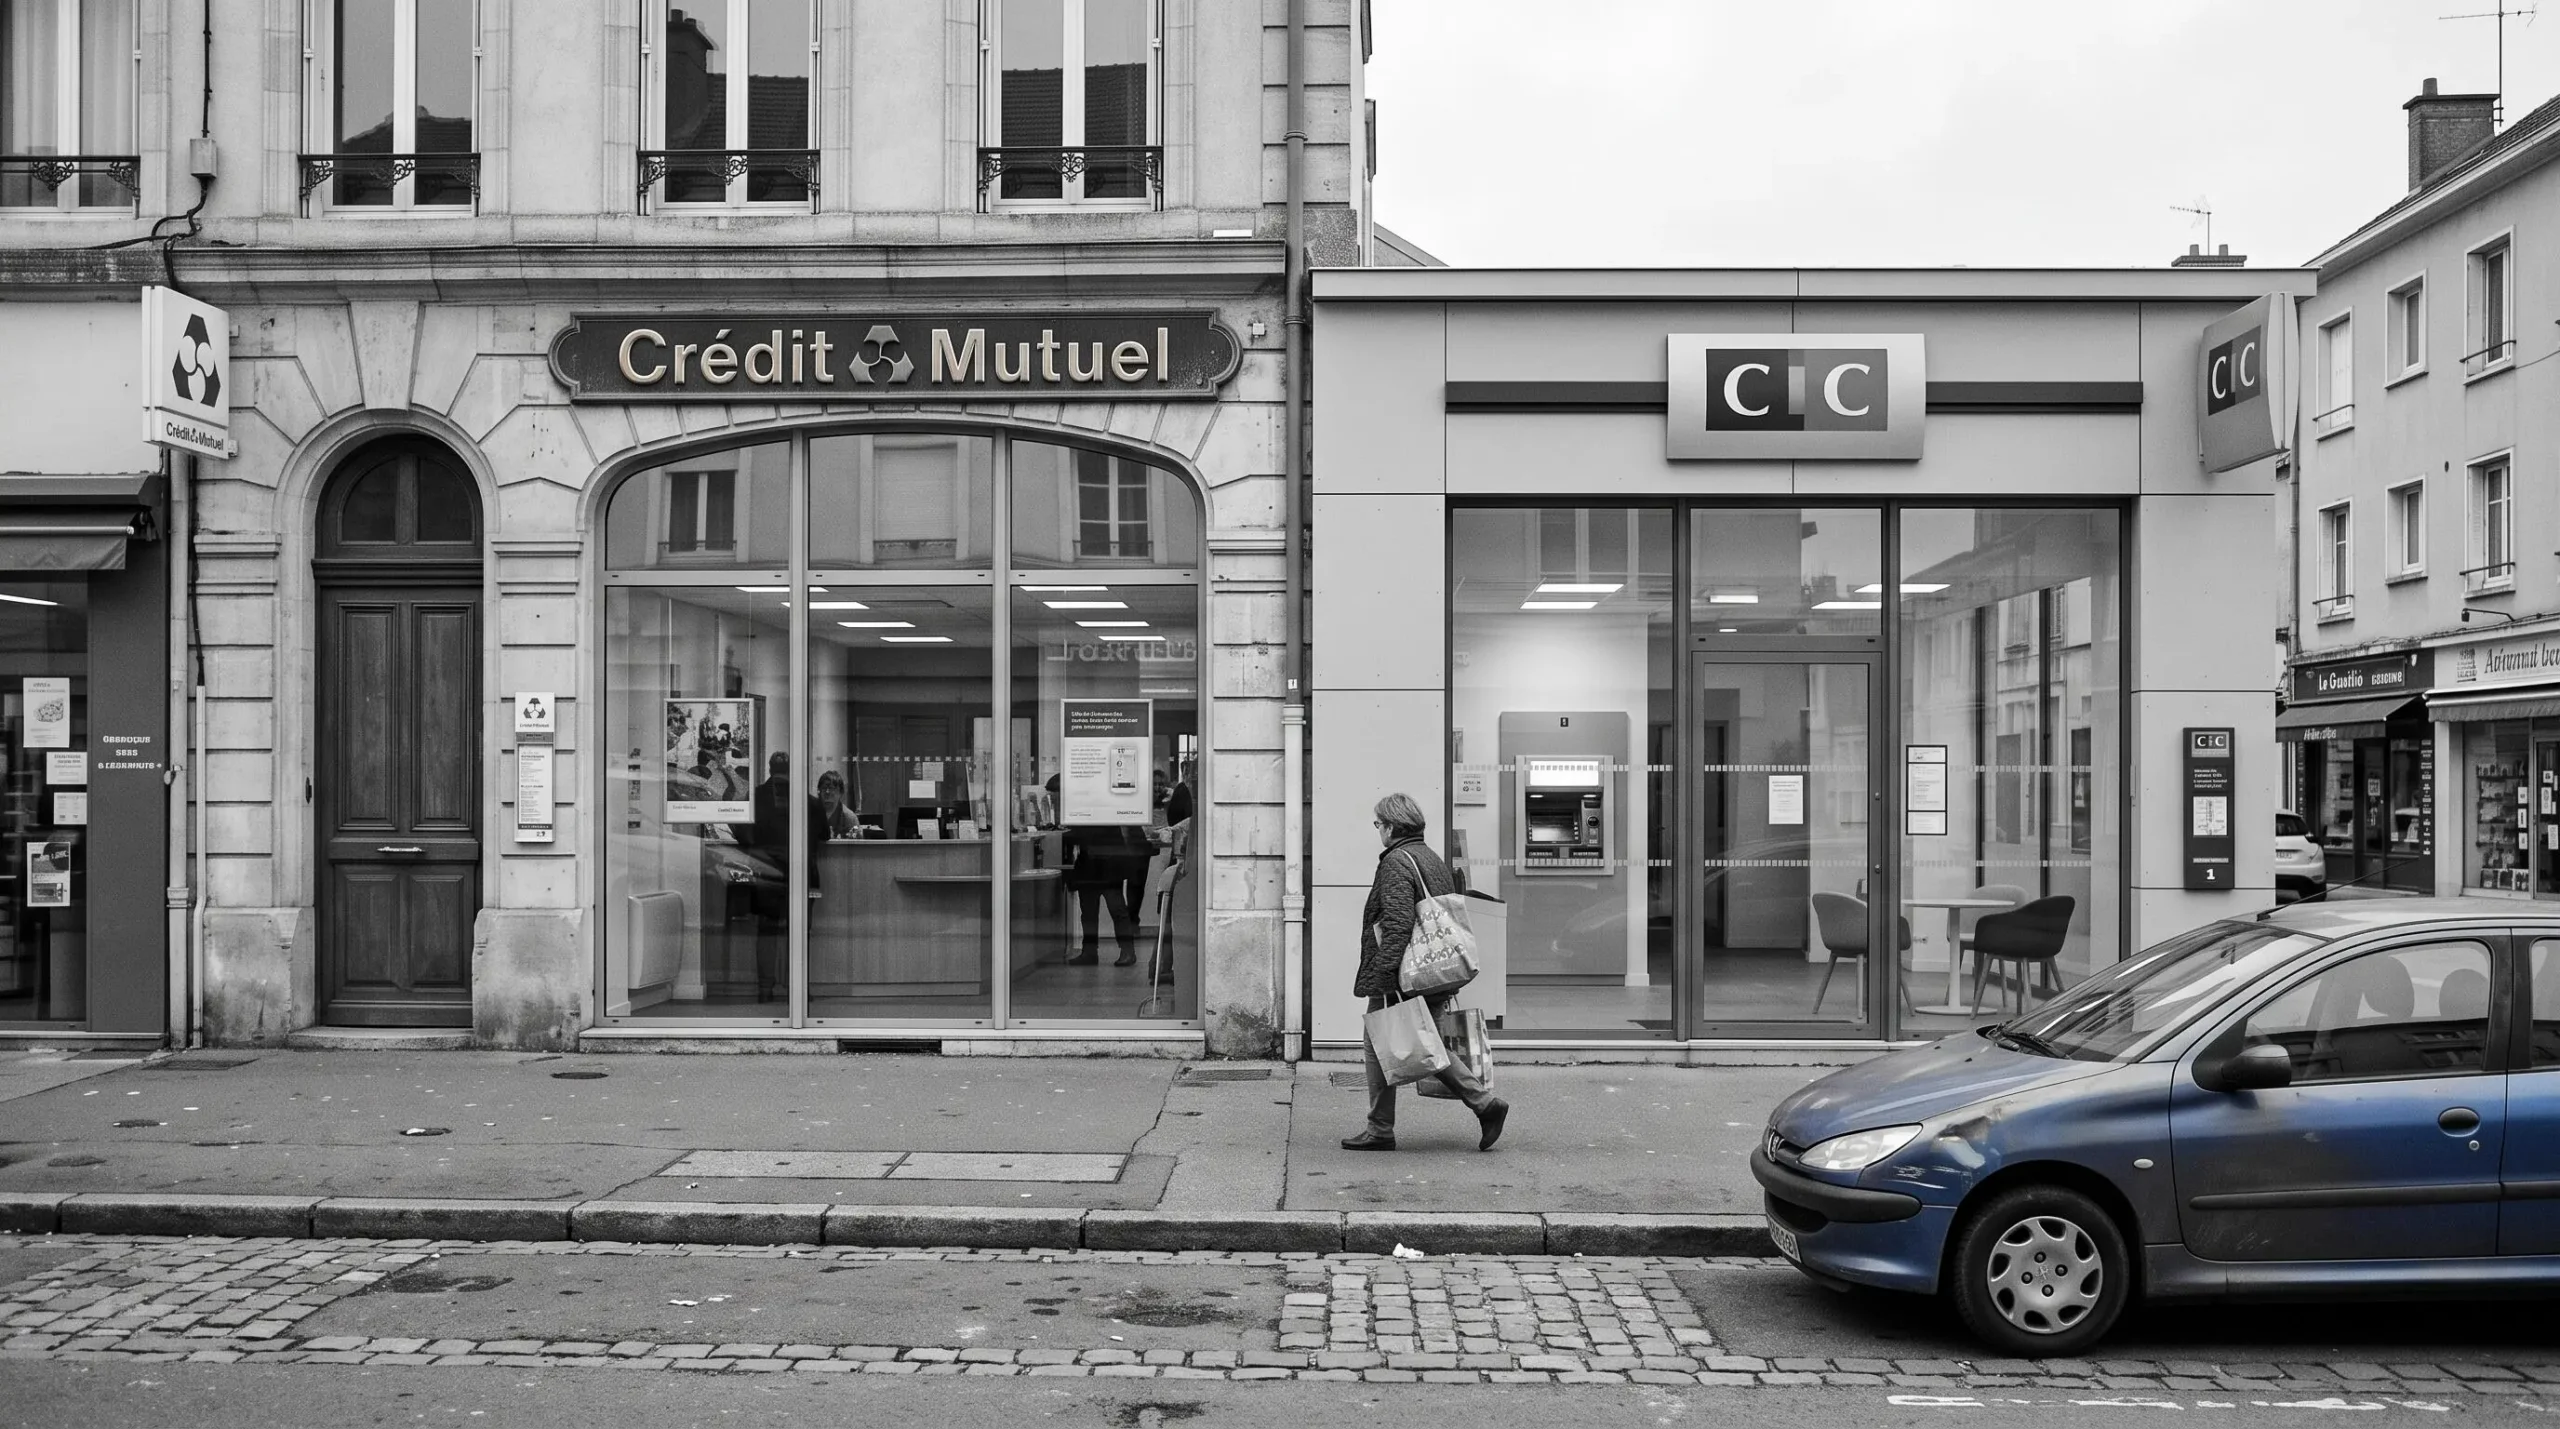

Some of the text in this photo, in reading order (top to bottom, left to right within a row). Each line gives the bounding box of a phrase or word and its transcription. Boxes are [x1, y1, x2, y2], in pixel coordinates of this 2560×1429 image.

[618, 327, 1168, 384] Crédit Mutuel
[2211, 341, 2255, 399] CIC
[1723, 363, 1870, 417] CIC
[2206, 868, 2216, 880] 1
